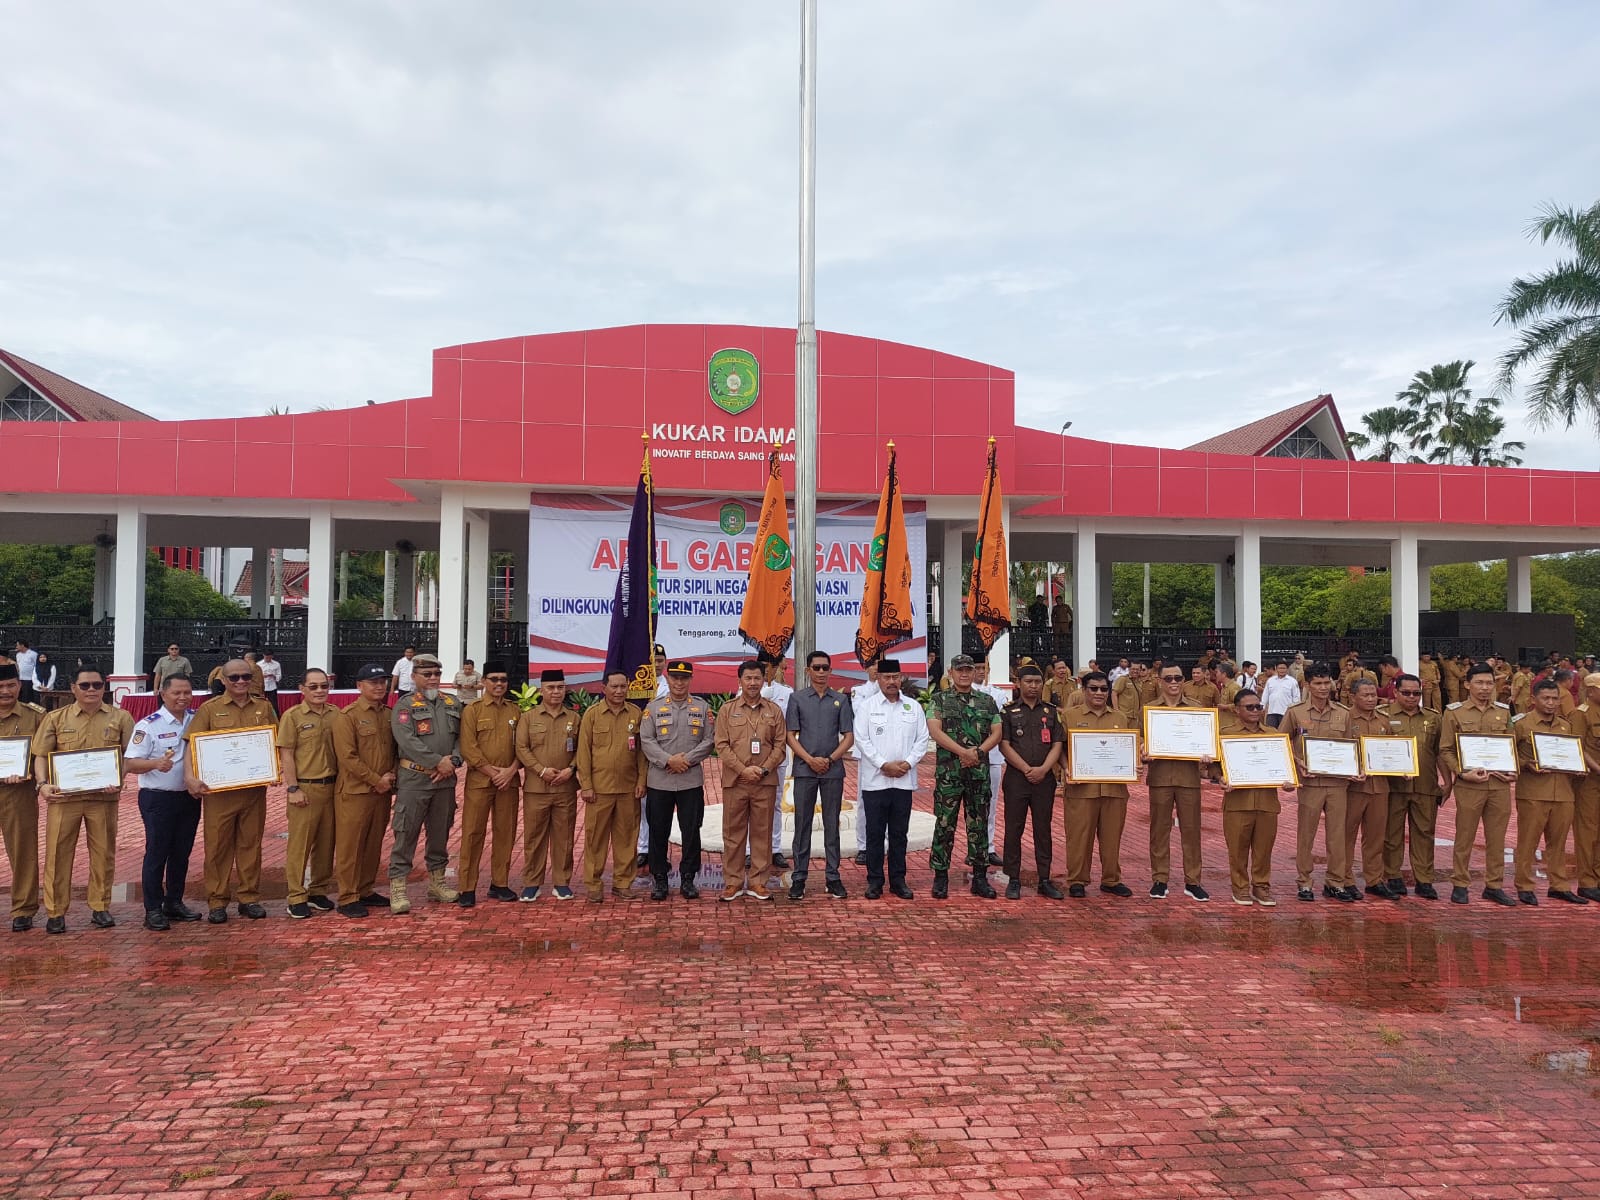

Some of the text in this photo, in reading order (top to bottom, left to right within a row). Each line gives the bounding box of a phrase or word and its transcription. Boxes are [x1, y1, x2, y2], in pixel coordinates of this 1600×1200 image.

[652, 423, 796, 444] KUKAR IDAMA
[652, 449, 692, 458] INOVATIF
[695, 450, 736, 460] BERDAYA
[738, 452, 765, 461] SAING
[684, 579, 713, 594] SIPIL
[716, 580, 748, 594] NEGA
[825, 580, 848, 595] ASN
[657, 600, 716, 615] MERINTAH
[678, 629, 726, 638] Tenggarong,
